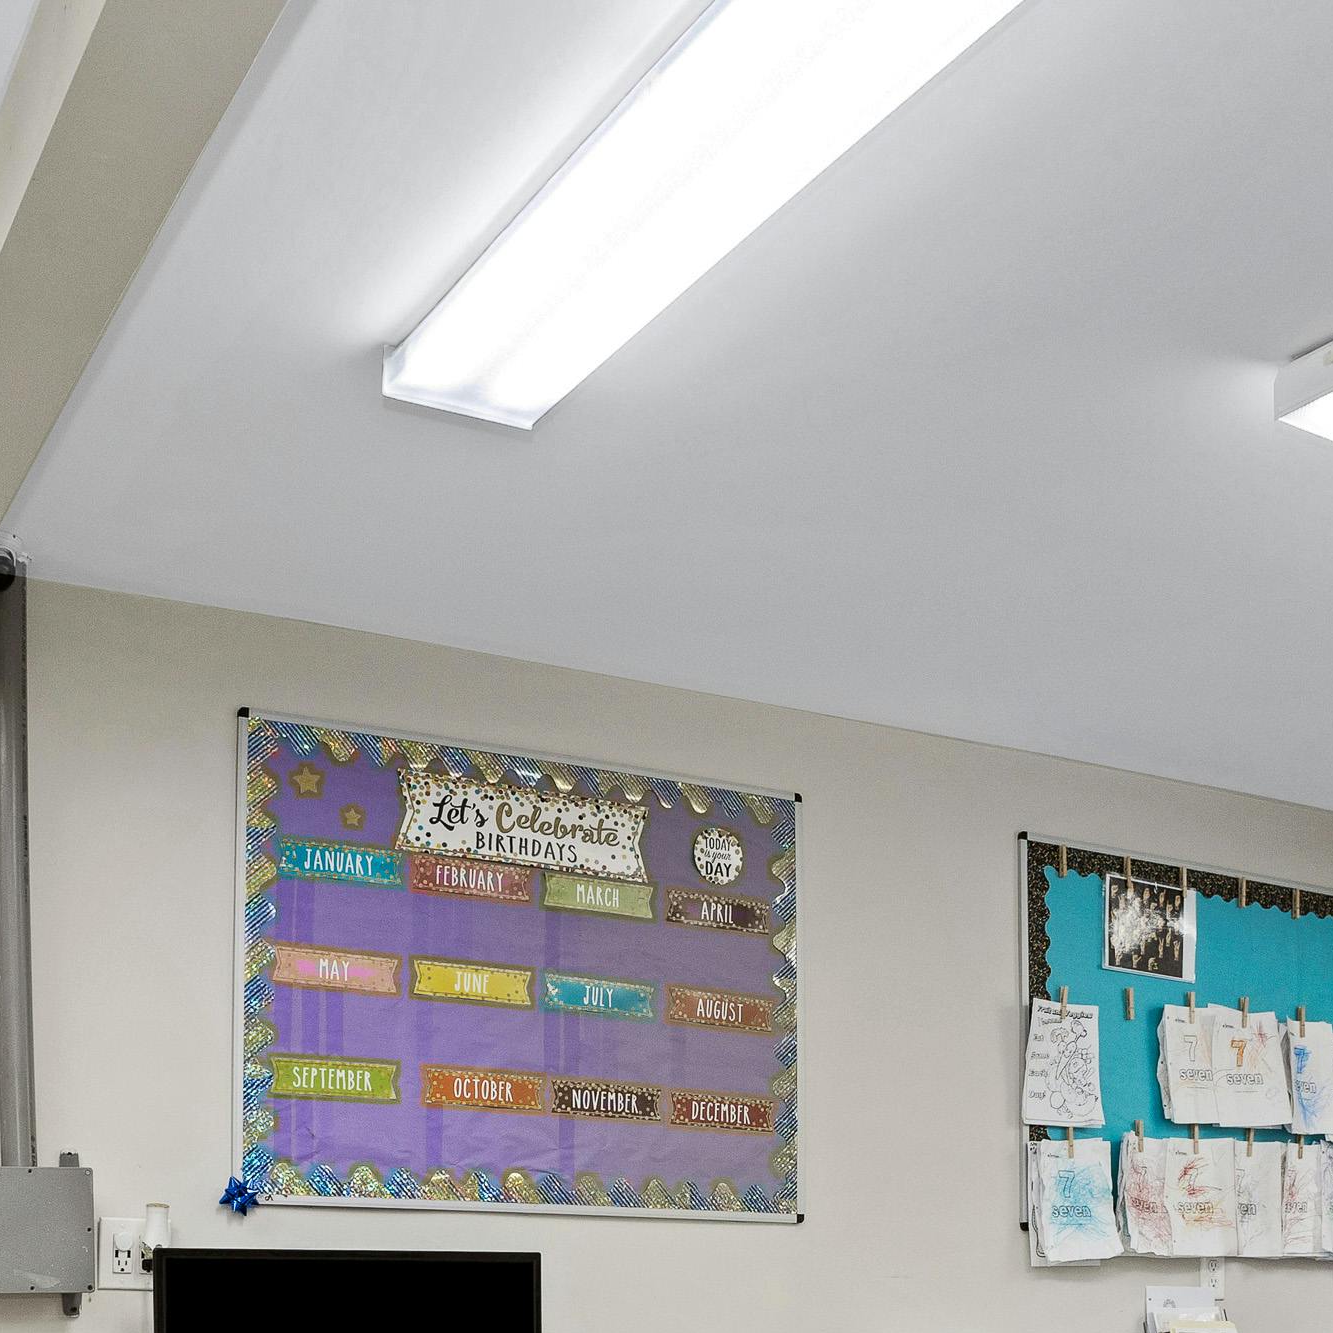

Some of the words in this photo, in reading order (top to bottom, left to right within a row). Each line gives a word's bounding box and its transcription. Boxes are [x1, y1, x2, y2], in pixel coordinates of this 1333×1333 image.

[429, 795, 489, 831] Let's
[495, 801, 620, 846] Celebrate
[475, 831, 577, 863] BIRTHDAYS
[704, 837, 732, 851] TODAY
[303, 848, 374, 877] JANUARY
[704, 849, 713, 860] is
[713, 850, 732, 865] your
[436, 865, 504, 892] FEBRUARY
[705, 862, 732, 877] DAY
[576, 884, 620, 908] MARCH
[701, 903, 734, 925] APRIL
[319, 958, 350, 982] MAY
[454, 971, 489, 994] JUNE
[583, 985, 614, 1008] JULY
[696, 998, 744, 1023] AUGUST
[1183, 1035, 1197, 1062] 7
[1230, 1038, 1247, 1067] 7
[292, 1066, 372, 1092] SEPTEMBER
[1179, 1067, 1213, 1081] seven
[1226, 1072, 1264, 1086] seven
[453, 1077, 514, 1102] OCTOBER
[572, 1089, 639, 1114] NOVEMBER
[691, 1101, 751, 1126] DECEMBER
[1058, 1170, 1075, 1198] 7
[1052, 1204, 1091, 1218] seven
[1177, 1201, 1214, 1215] seven
